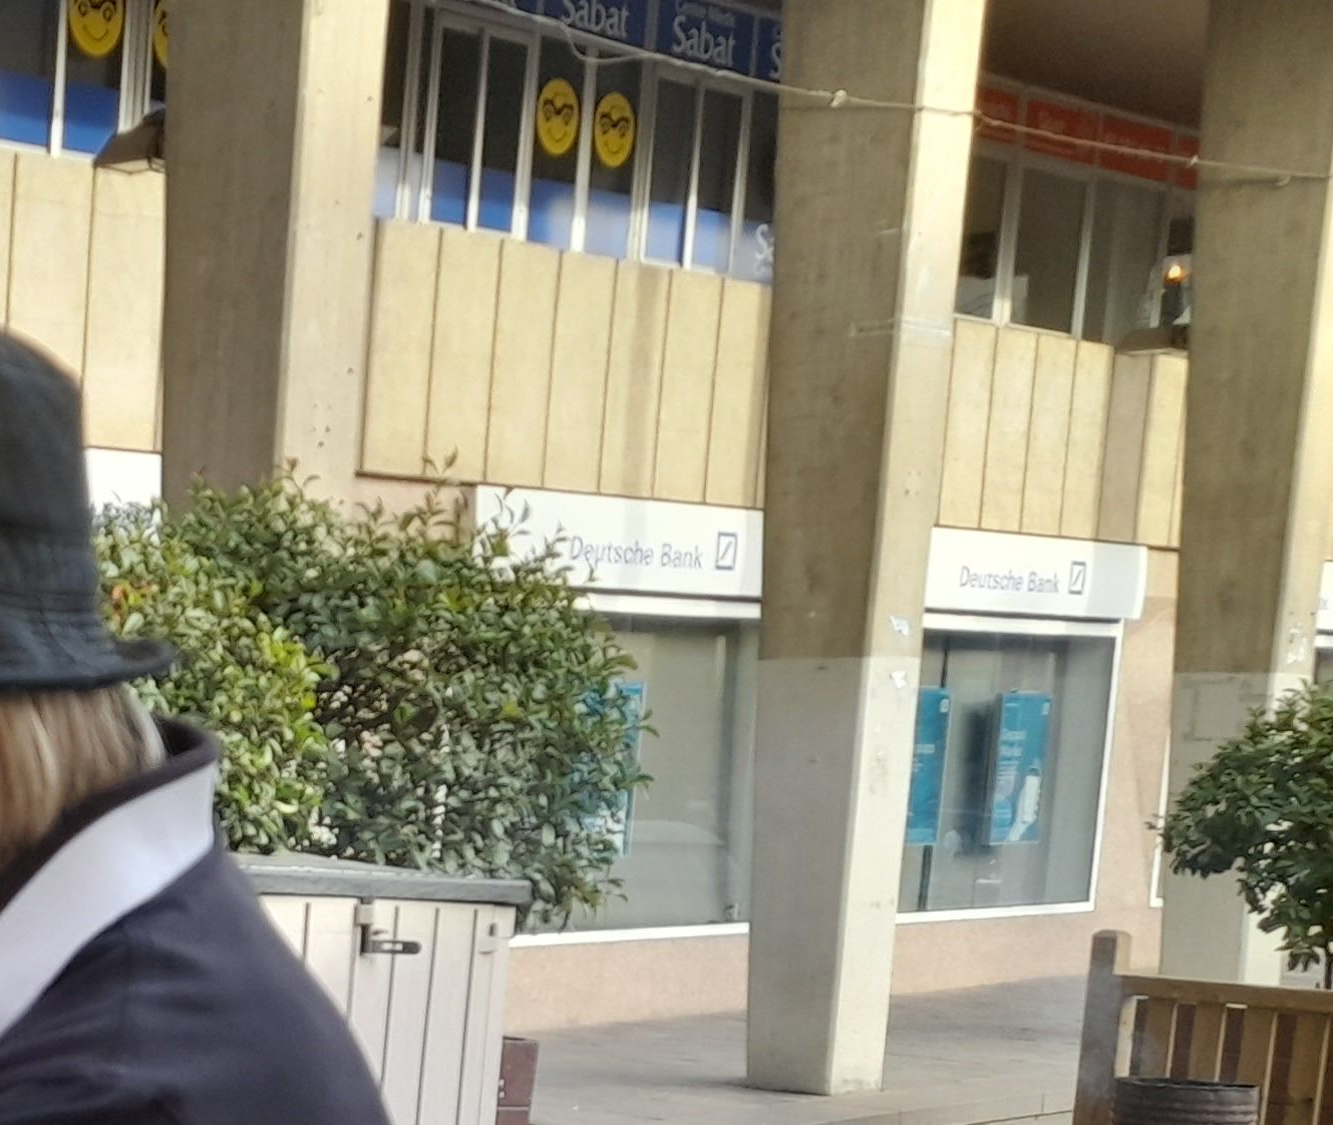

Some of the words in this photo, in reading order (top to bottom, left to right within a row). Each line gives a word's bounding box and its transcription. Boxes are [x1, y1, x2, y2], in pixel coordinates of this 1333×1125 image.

[673, 14, 736, 67] Sabat
[569, 535, 654, 567] Deutsche
[660, 542, 703, 569] Bank
[959, 564, 1023, 592] Deutsche
[1027, 570, 1060, 594] Bank
